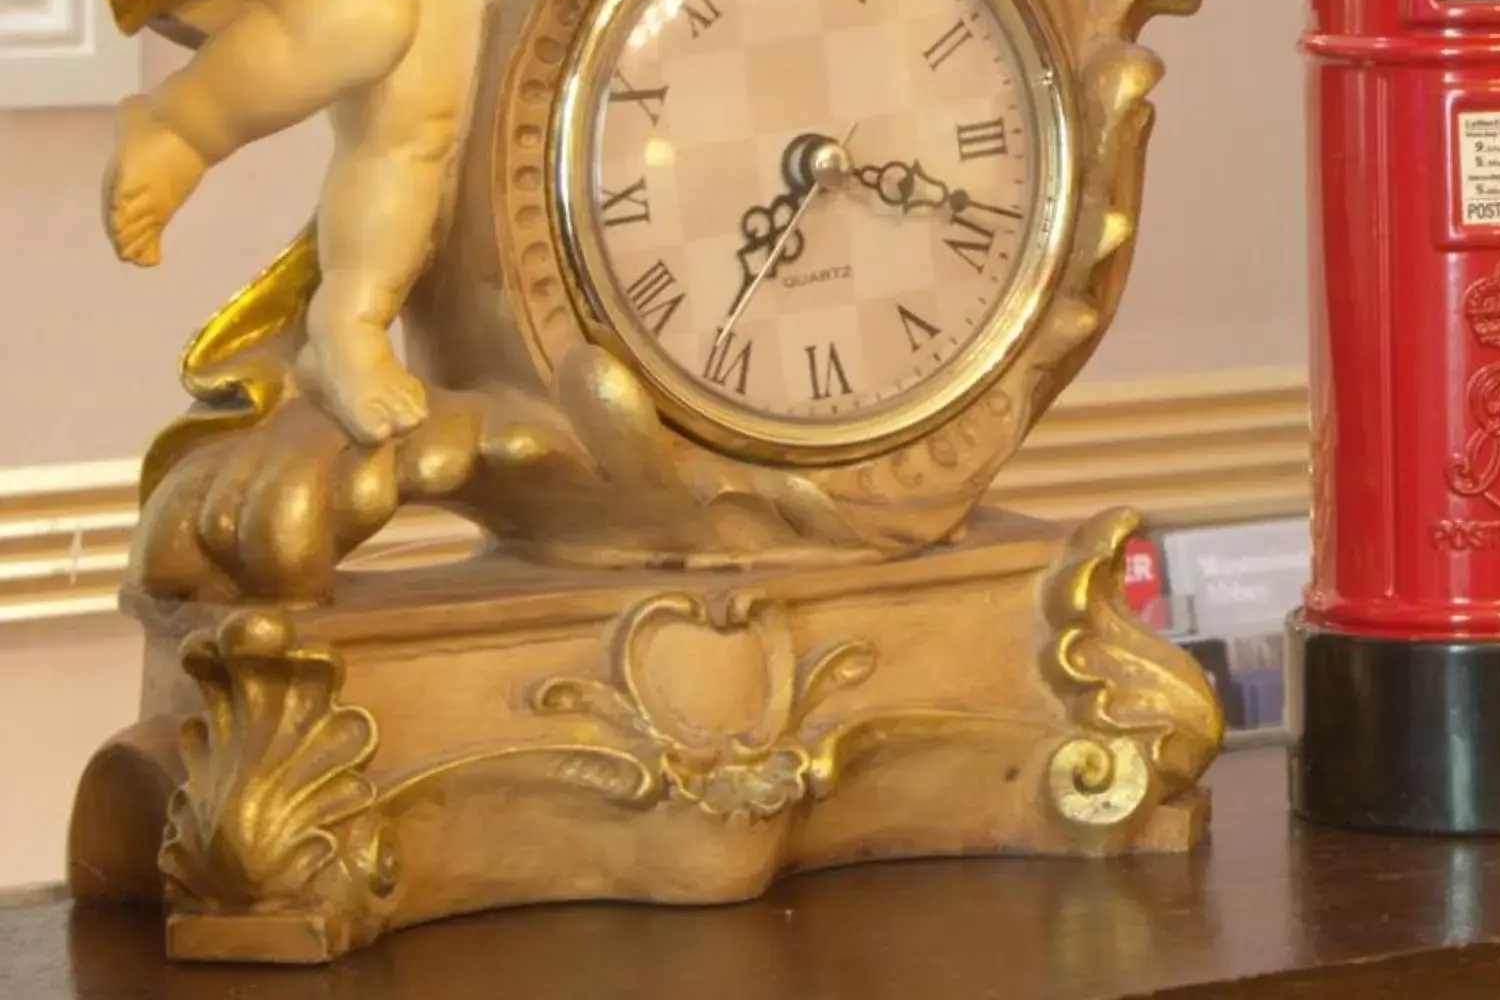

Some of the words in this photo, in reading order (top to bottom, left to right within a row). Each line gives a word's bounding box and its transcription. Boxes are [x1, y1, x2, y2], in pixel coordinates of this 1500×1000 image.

[923, 21, 973, 71] II
[608, 67, 670, 128] X
[956, 117, 1008, 161] III
[943, 212, 995, 274] IV
[626, 260, 686, 337] VIII
[782, 265, 853, 288] QUARTZ
[896, 303, 941, 352] V
[702, 326, 753, 396] VII
[804, 342, 854, 400] VI
